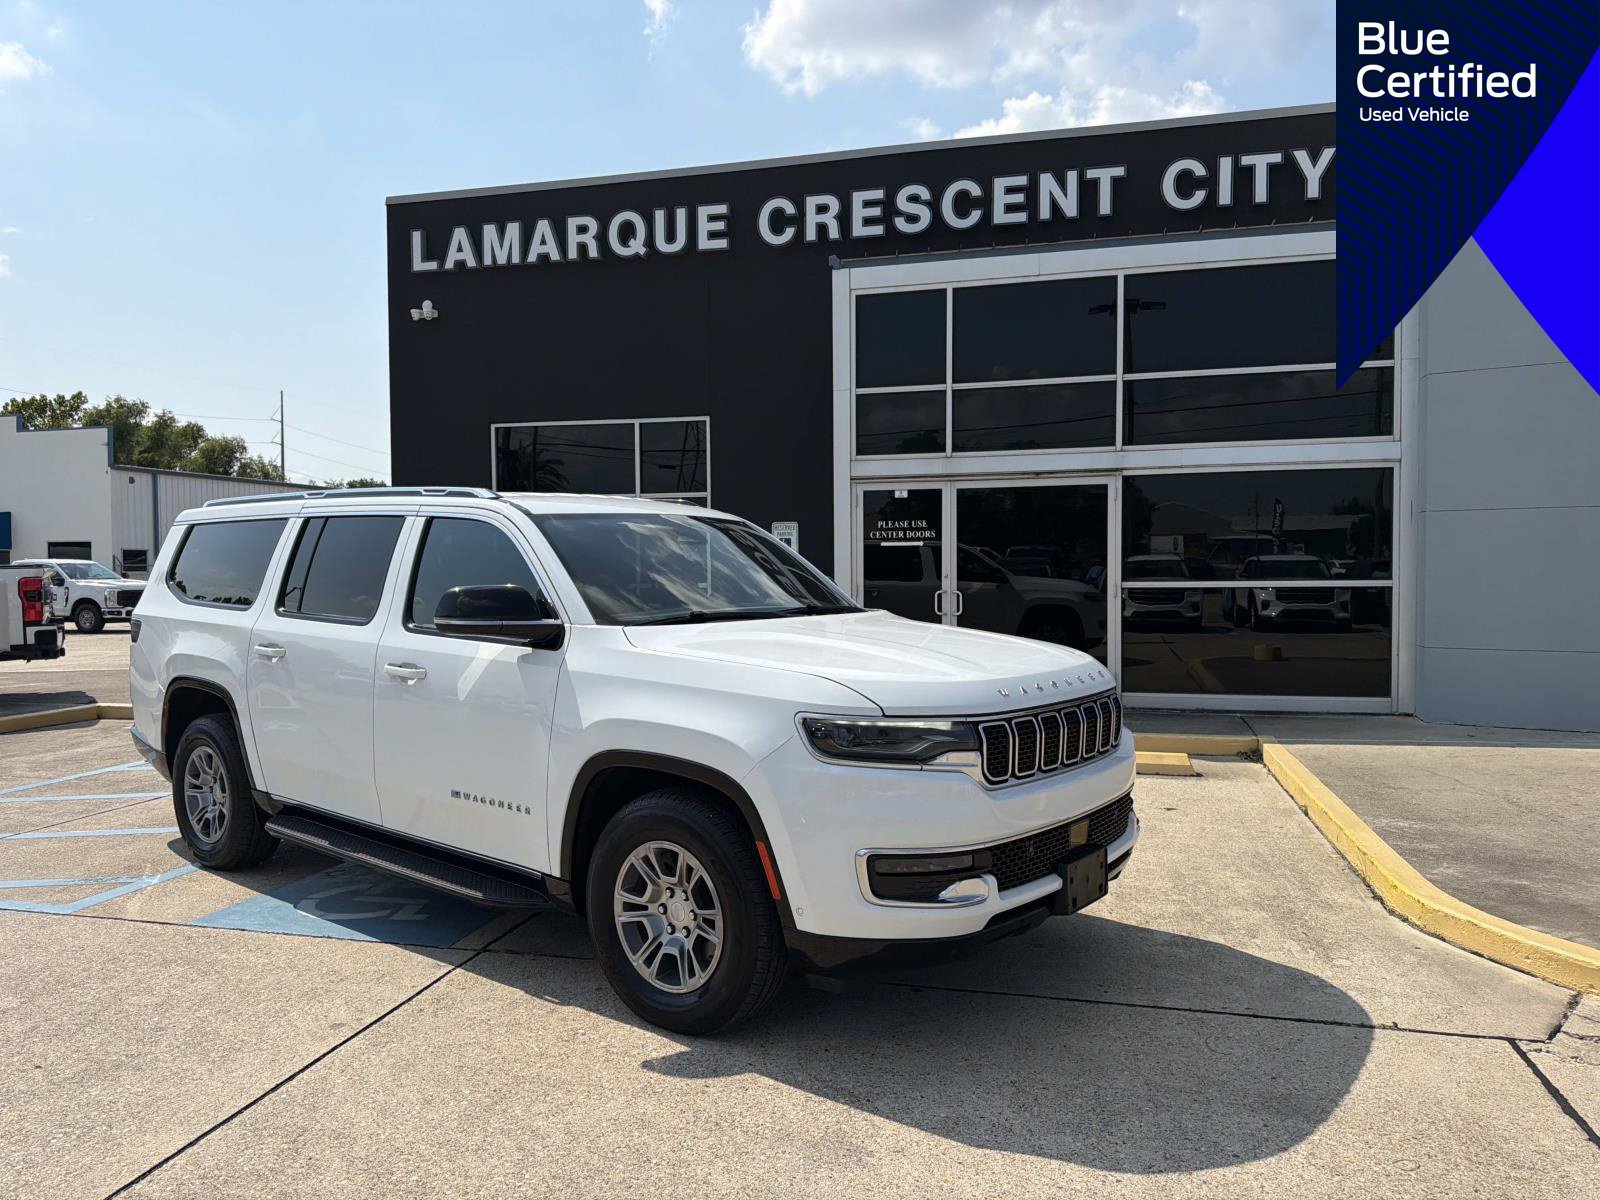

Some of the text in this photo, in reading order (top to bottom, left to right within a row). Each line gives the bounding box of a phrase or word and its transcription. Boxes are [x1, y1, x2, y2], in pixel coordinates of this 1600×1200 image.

[410, 146, 1336, 273] LAMARQUE CRESCENT CITY
[878, 519, 928, 529] PLEASE USE
[870, 530, 936, 539] CENTER DOORS
[463, 791, 531, 815] WAGONEER
